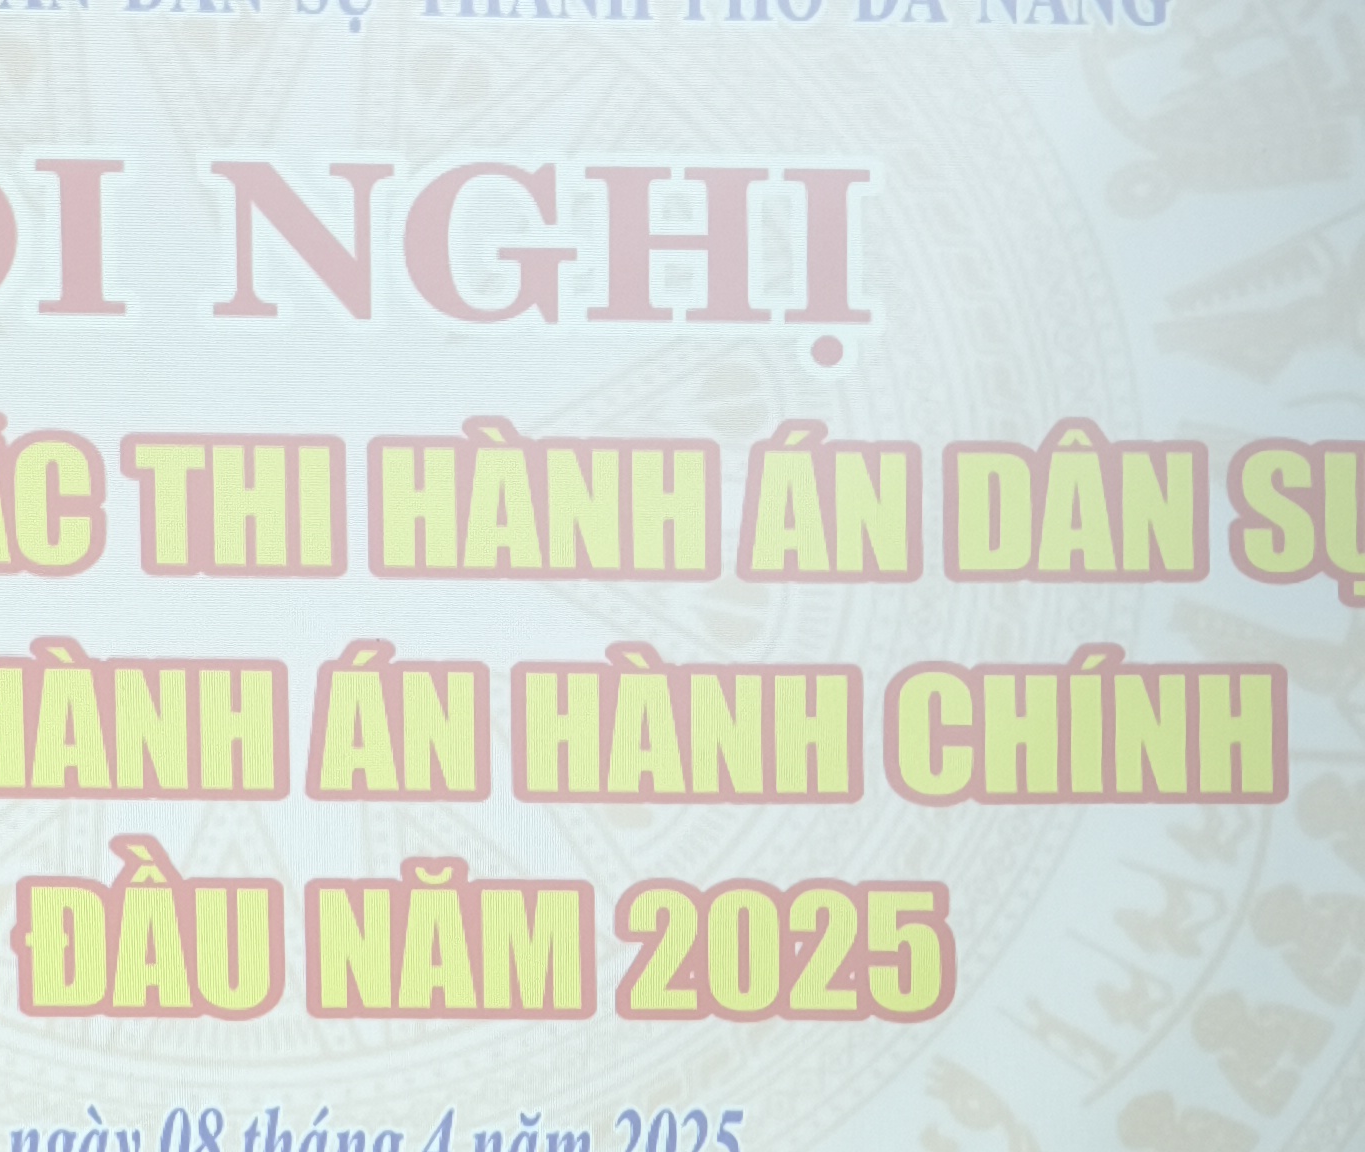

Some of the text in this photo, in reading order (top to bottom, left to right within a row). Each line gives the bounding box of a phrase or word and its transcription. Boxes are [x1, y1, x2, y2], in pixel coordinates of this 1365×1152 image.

[213, 163, 869, 365] NGHỊ
[120, 433, 347, 578] THI
[368, 417, 721, 581] HÀNH
[737, 421, 923, 583] ÁN
[943, 419, 1209, 583] DÂN
[305, 640, 491, 802] ÁN
[511, 641, 864, 805] HÀNH
[883, 644, 1289, 807] CHÍNH
[10, 834, 285, 1022] ĐẦU
[304, 857, 597, 1021] NĂM
[614, 879, 956, 1024] 2025
